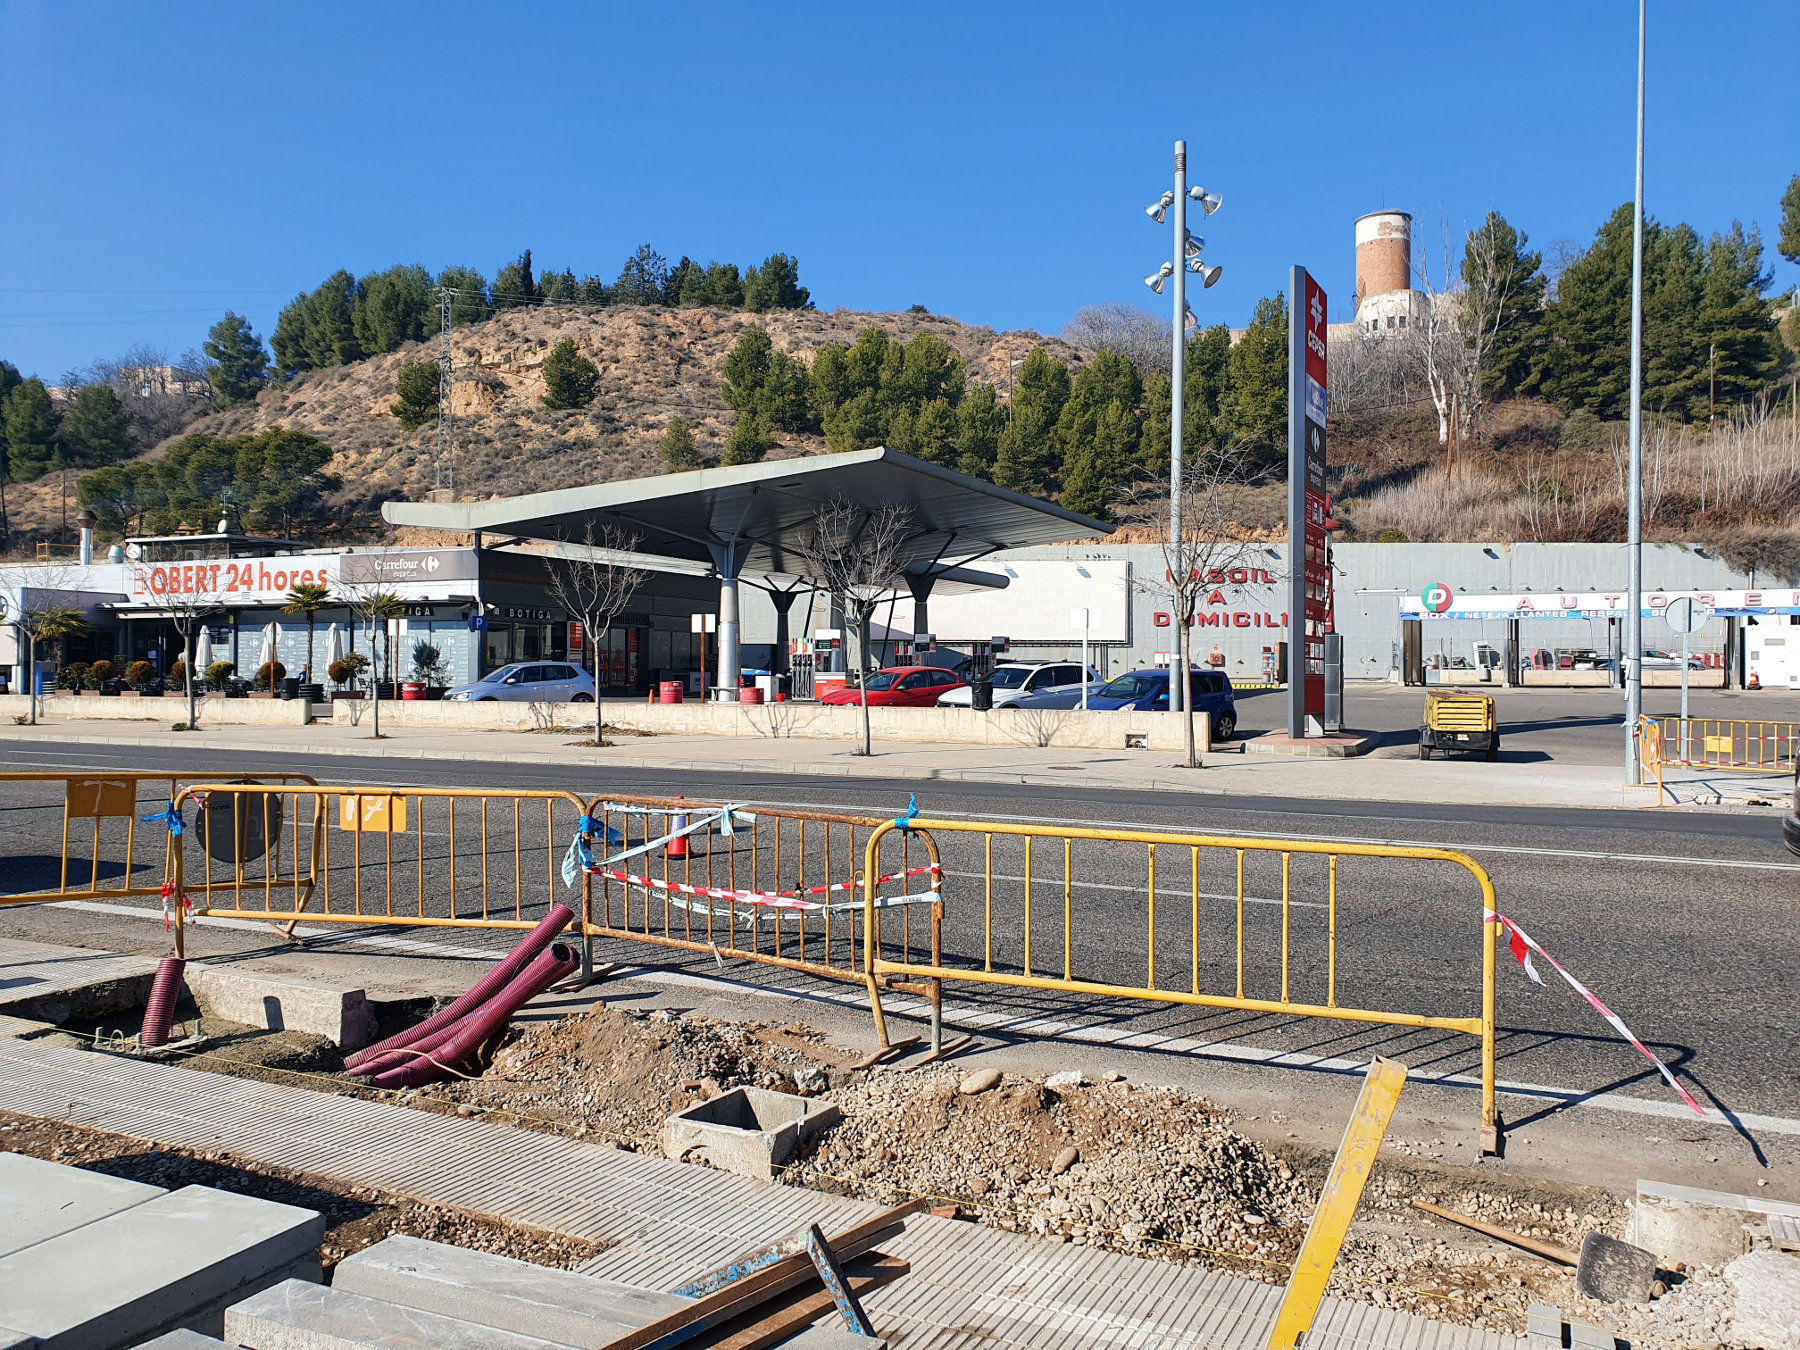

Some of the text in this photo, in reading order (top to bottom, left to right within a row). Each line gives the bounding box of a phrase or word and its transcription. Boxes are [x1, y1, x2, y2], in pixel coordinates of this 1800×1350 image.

[1308, 329, 1325, 361] CEPSA
[1308, 456, 1323, 477] Carrefour
[374, 558, 419, 570] Carrefour
[151, 561, 328, 595] OBERT 24 hores
[1166, 568, 1278, 584] ASOIL
[1207, 589, 1227, 605] A
[1427, 589, 1447, 604] D
[509, 608, 551, 620] BOTIGA
[1464, 611, 1509, 619] NETEJA
[1514, 610, 1568, 618] LLANTES
[475, 618, 483, 628] P
